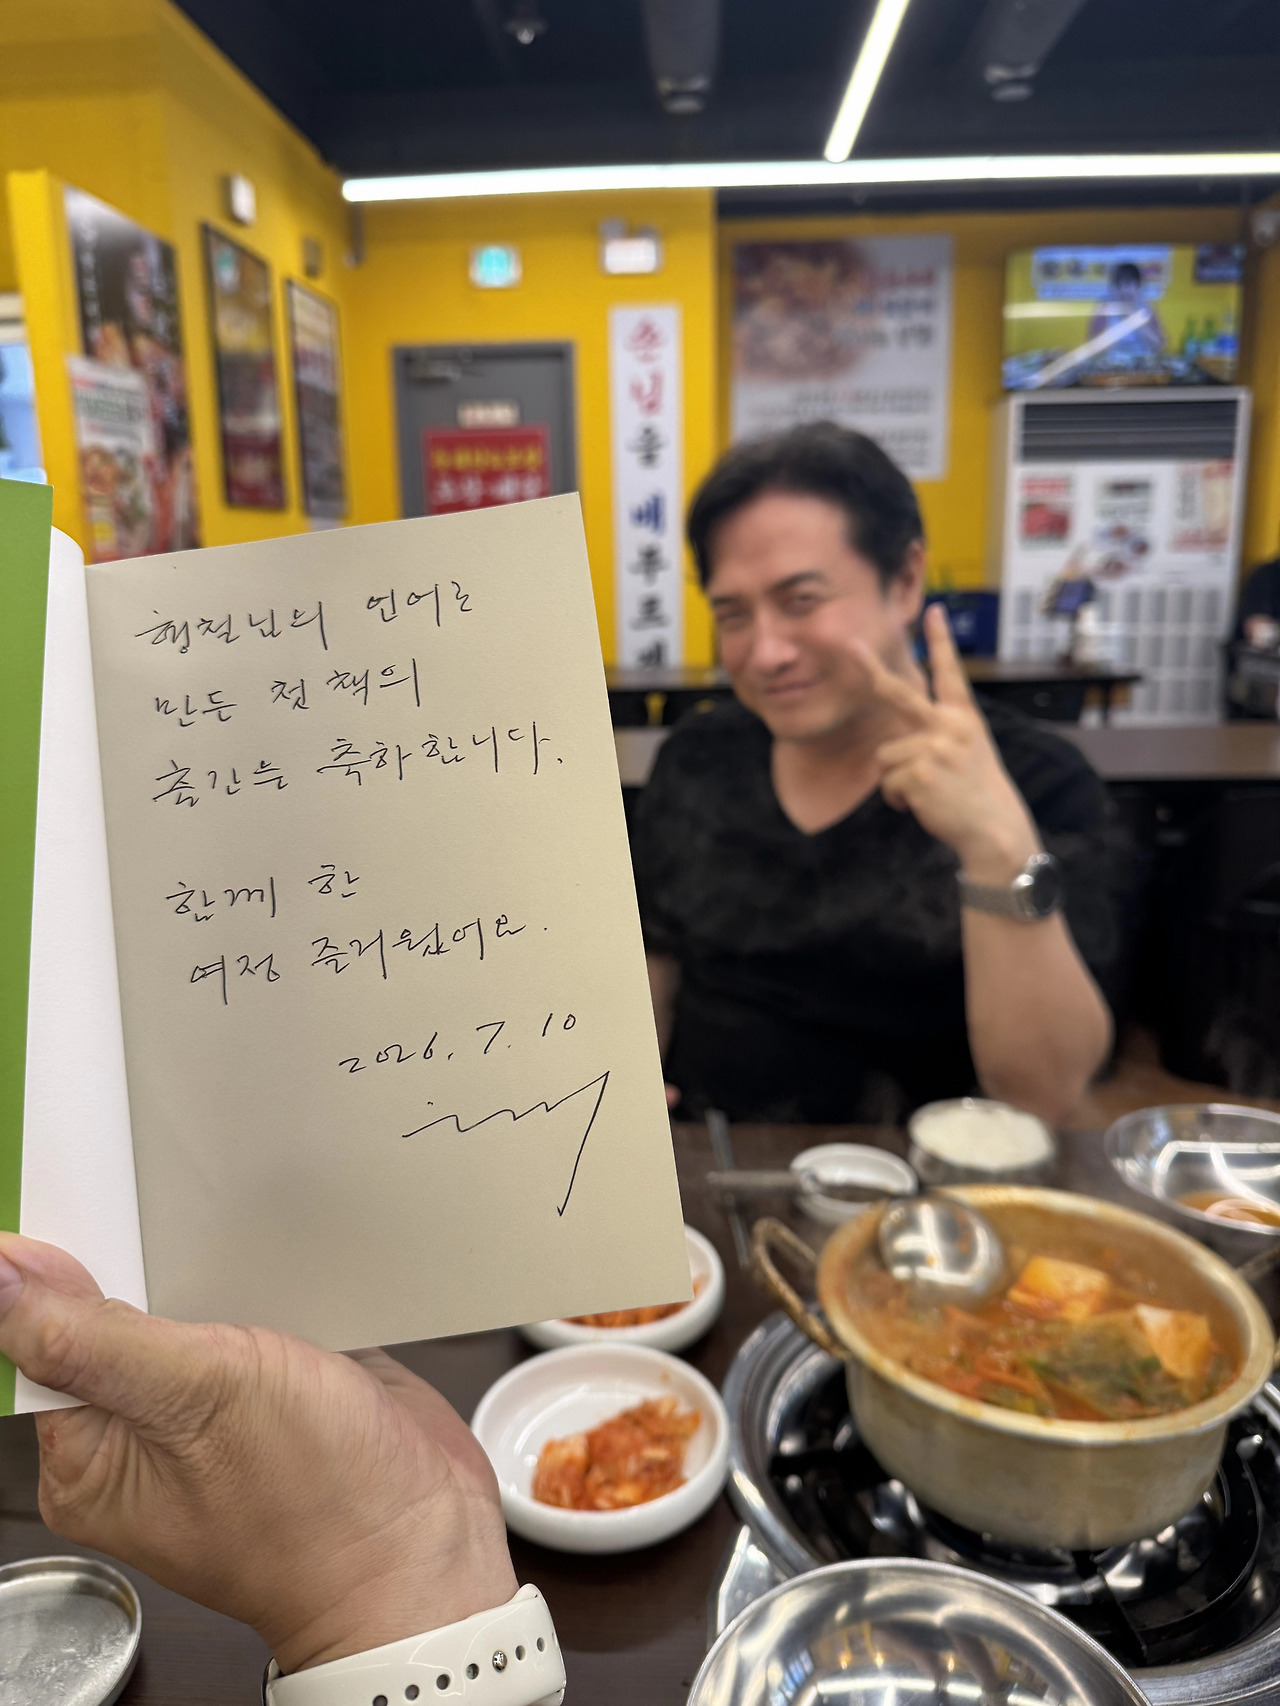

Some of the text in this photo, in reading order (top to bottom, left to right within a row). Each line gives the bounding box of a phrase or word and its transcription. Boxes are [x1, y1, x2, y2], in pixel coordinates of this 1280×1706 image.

[366, 580, 474, 628] 언어로
[154, 656, 421, 728] 만든 첫 책의
[151, 758, 289, 808] 출간을
[165, 863, 361, 924] 함께 한
[189, 912, 549, 1006] 여정 즐거웠어요.
[541, 1012, 577, 1039] 10
